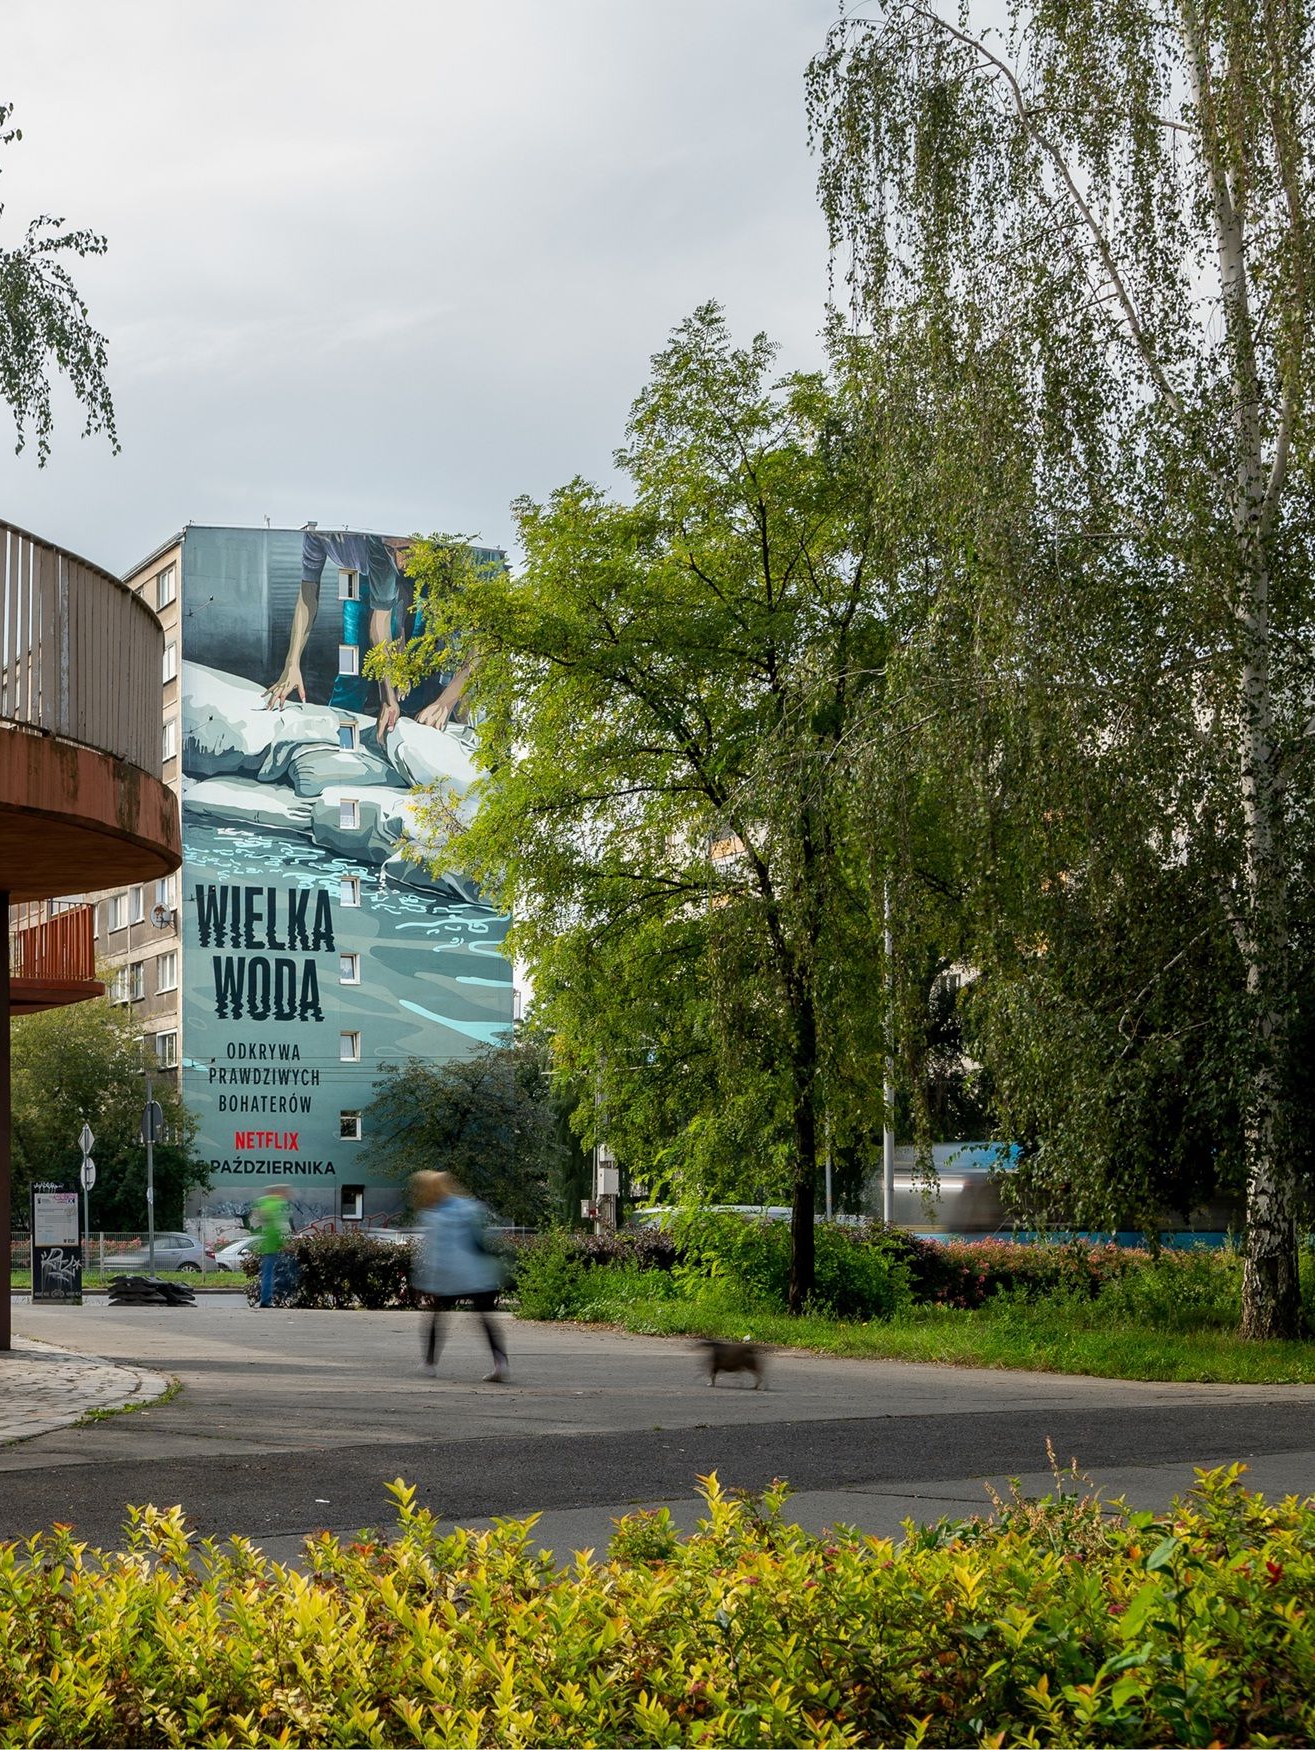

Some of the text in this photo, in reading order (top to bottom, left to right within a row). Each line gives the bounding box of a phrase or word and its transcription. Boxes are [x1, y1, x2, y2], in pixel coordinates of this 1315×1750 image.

[195, 885, 336, 952] WIELKA
[213, 956, 325, 1022] WODA
[227, 1042, 301, 1061] ODKRYWA
[209, 1067, 320, 1086] PRAWDZIWYCH
[219, 1093, 312, 1113] BOHATERÓW
[235, 1131, 299, 1151] NETFLIX
